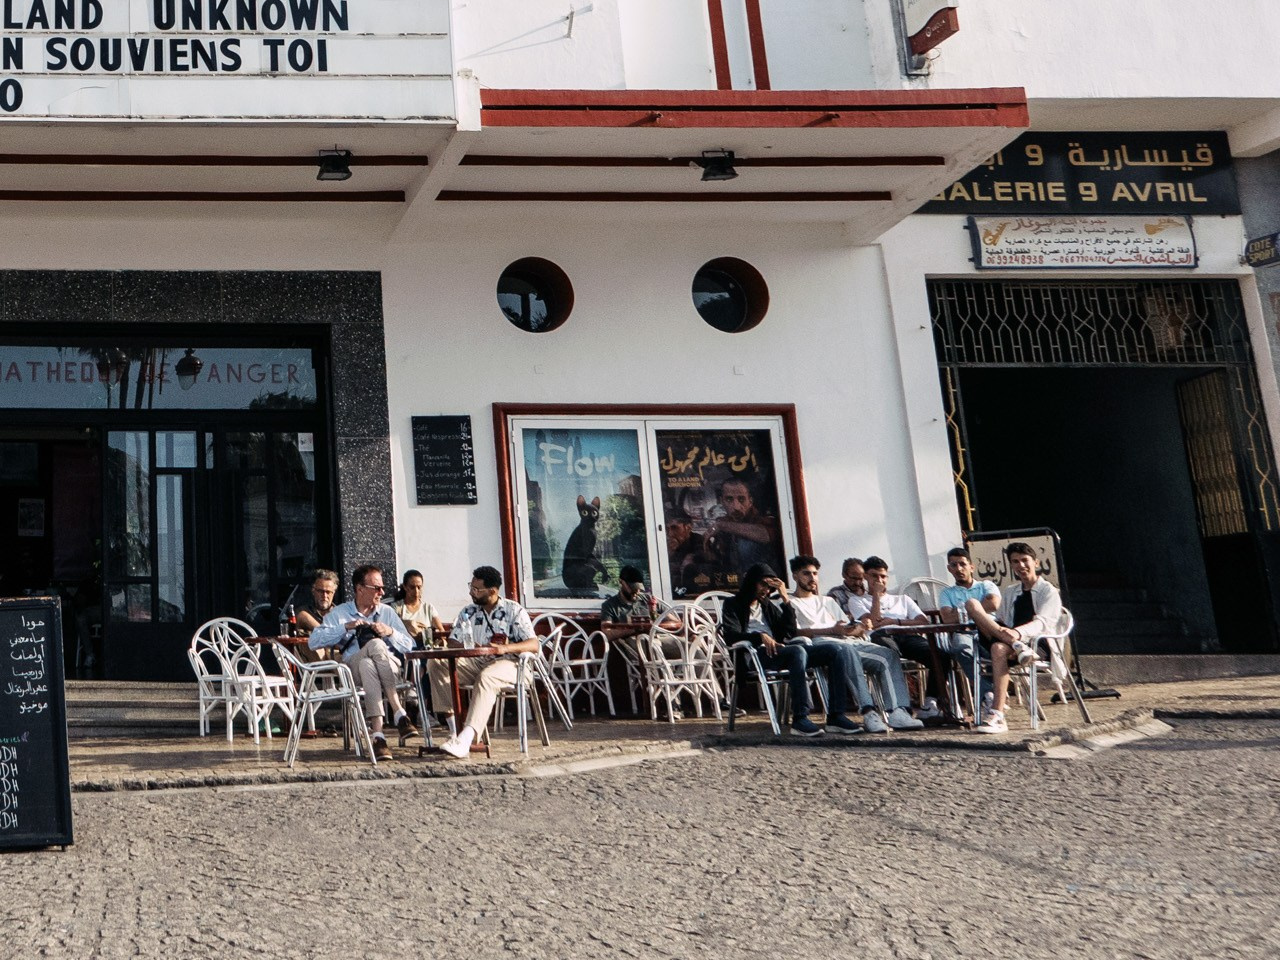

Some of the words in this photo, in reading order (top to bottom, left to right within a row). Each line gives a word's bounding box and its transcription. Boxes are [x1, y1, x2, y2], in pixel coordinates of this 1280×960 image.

[45, 38, 242, 73] SOUVIENS
[263, 39, 328, 73] TOI
[1068, 142, 1214, 171] قيسارية
[1078, 183, 1098, 202] 9
[1111, 182, 1208, 202] AVRIL
[1249, 248, 1275, 263] SPORT
[539, 442, 614, 477] Flow
